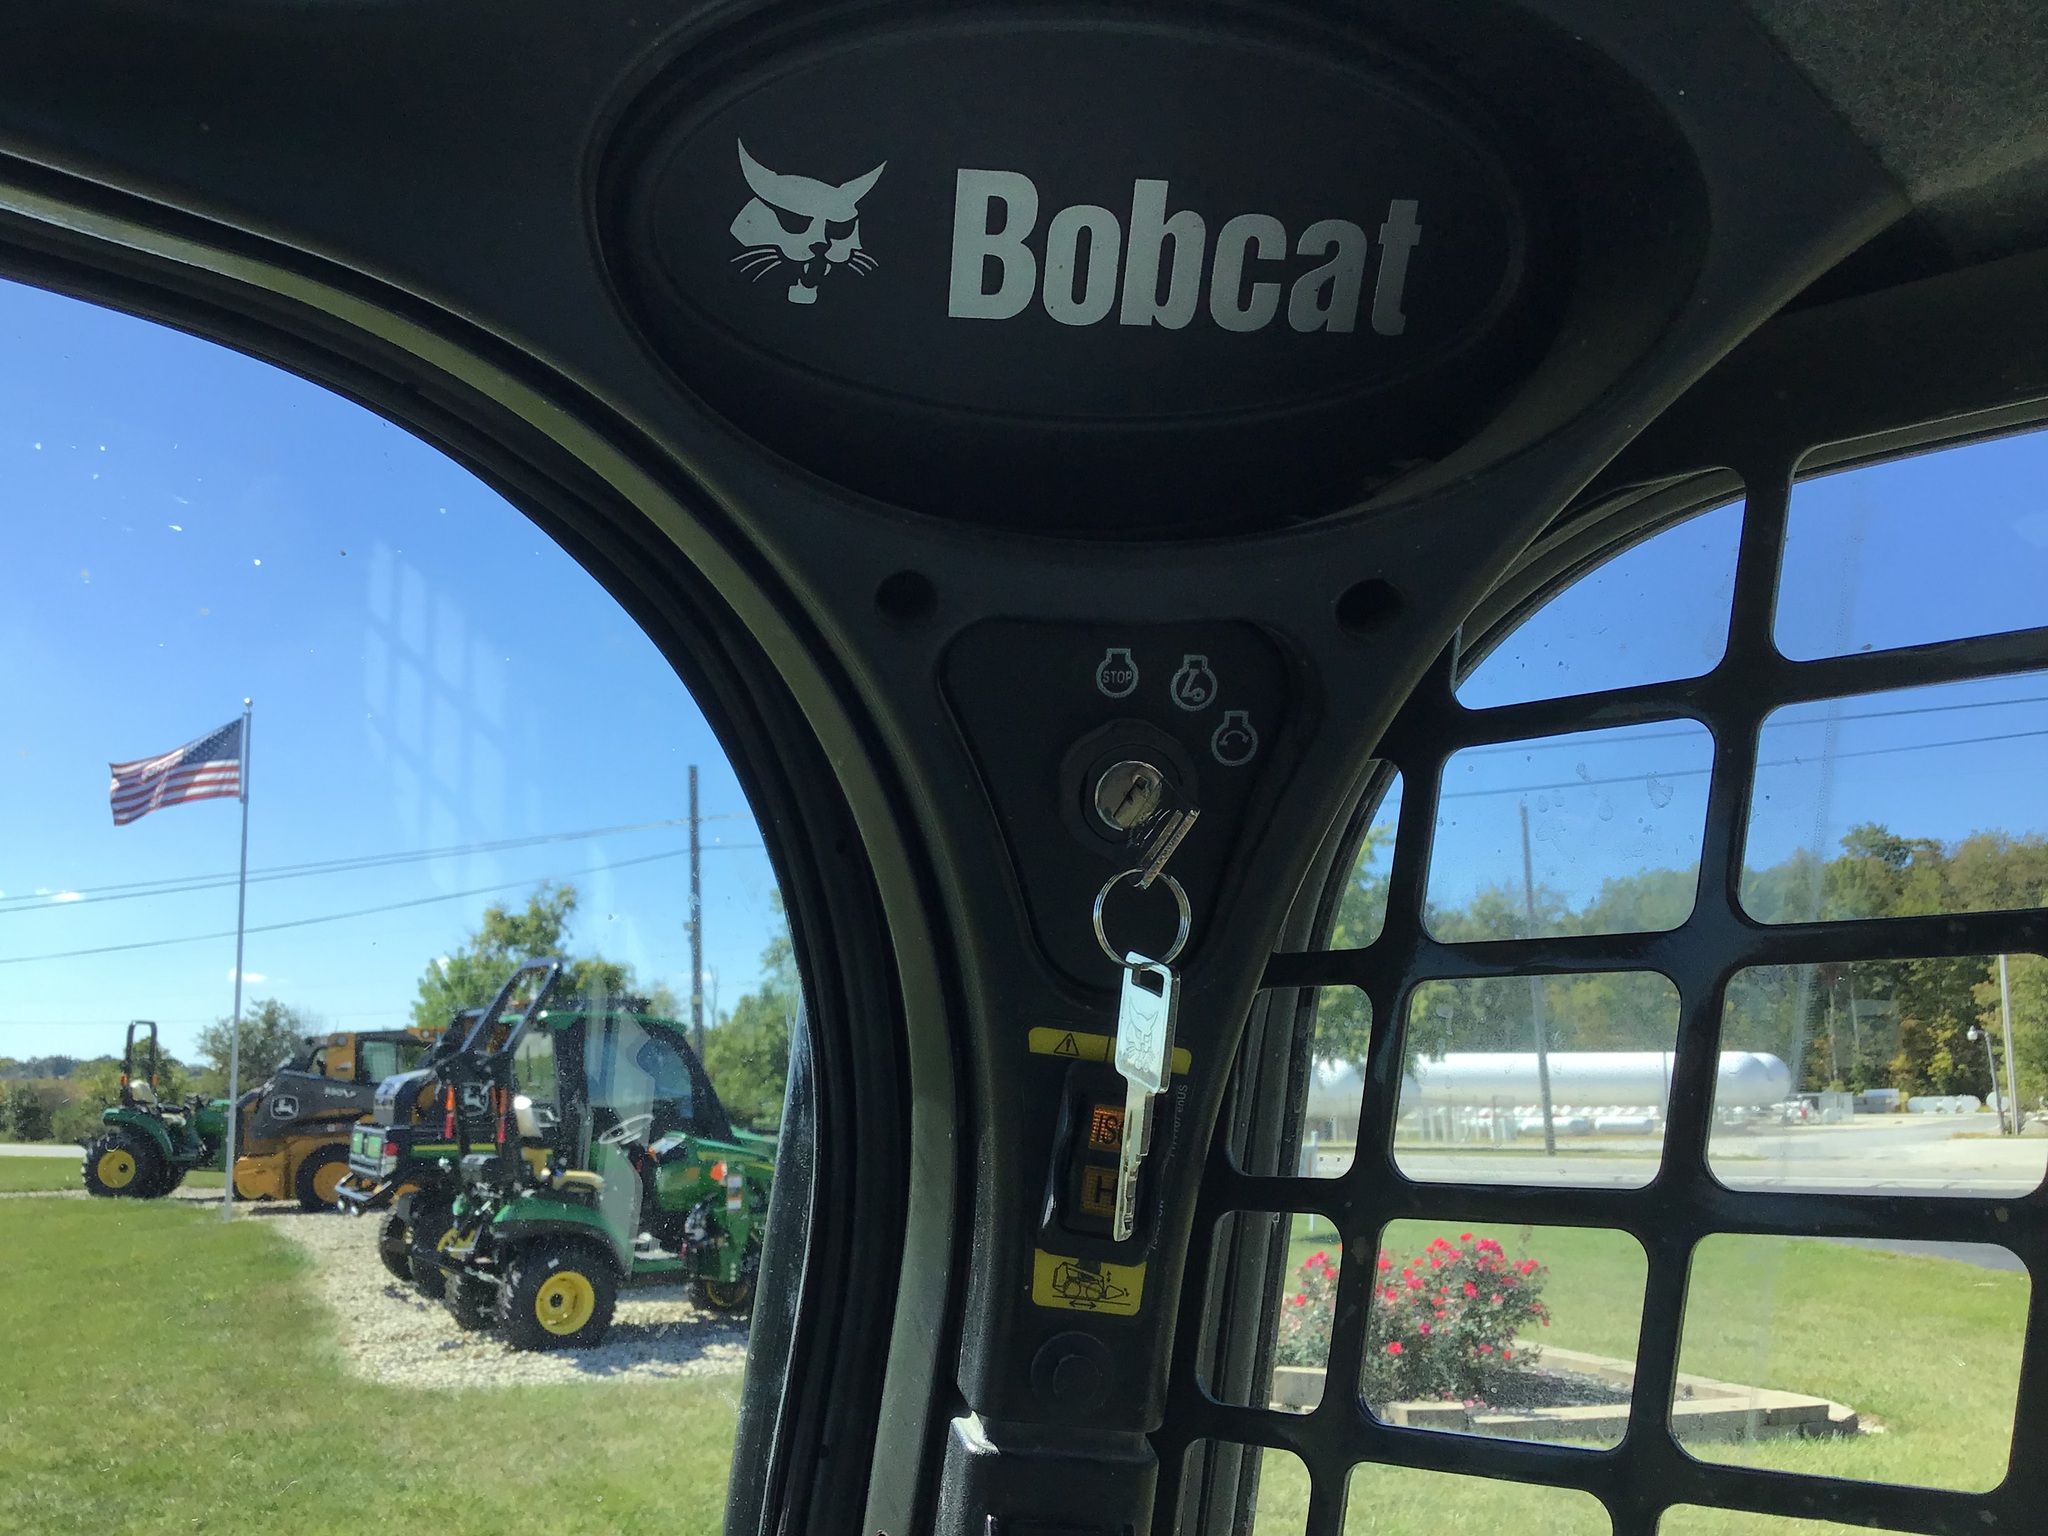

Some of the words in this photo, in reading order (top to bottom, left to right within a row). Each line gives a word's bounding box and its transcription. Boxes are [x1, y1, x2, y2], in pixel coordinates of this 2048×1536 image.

[948, 168, 1422, 336] Bobcat
[1102, 670, 1133, 683] STOP
[1097, 1115, 1123, 1144] IS
